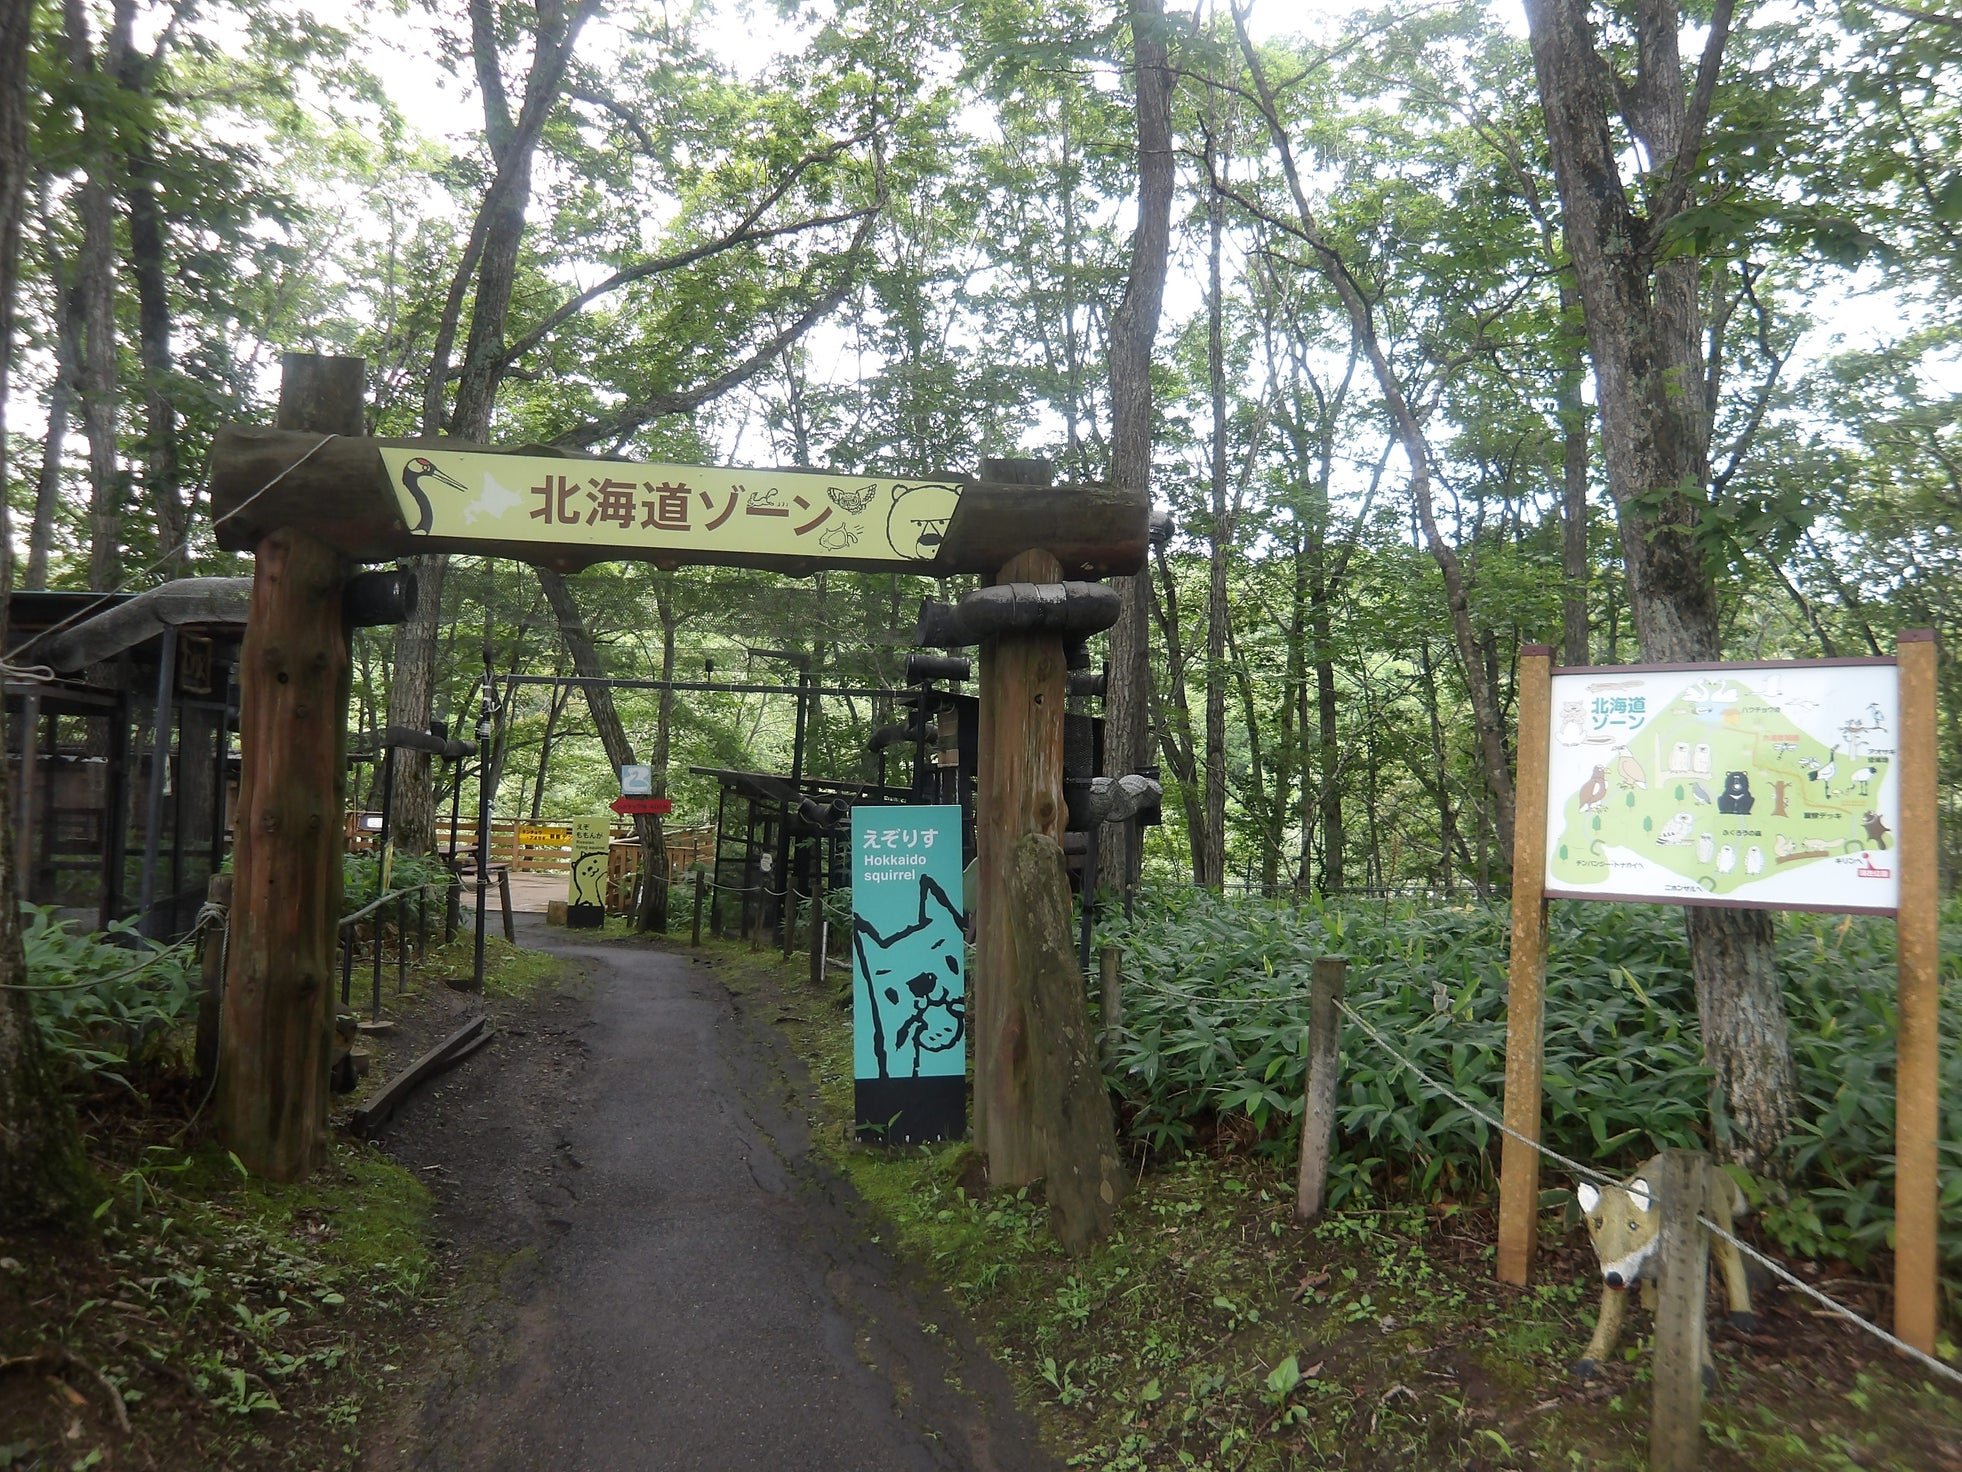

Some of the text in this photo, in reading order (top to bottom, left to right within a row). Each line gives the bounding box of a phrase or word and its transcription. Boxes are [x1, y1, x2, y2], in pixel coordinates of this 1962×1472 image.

[529, 475, 833, 537] 北海道ゾーン
[1591, 696, 1646, 714] 北海道
[1591, 714, 1645, 730] ゾーン
[863, 828, 939, 849] えぞりす
[864, 854, 927, 866] Hokkaido
[864, 869, 916, 883] squirrel
